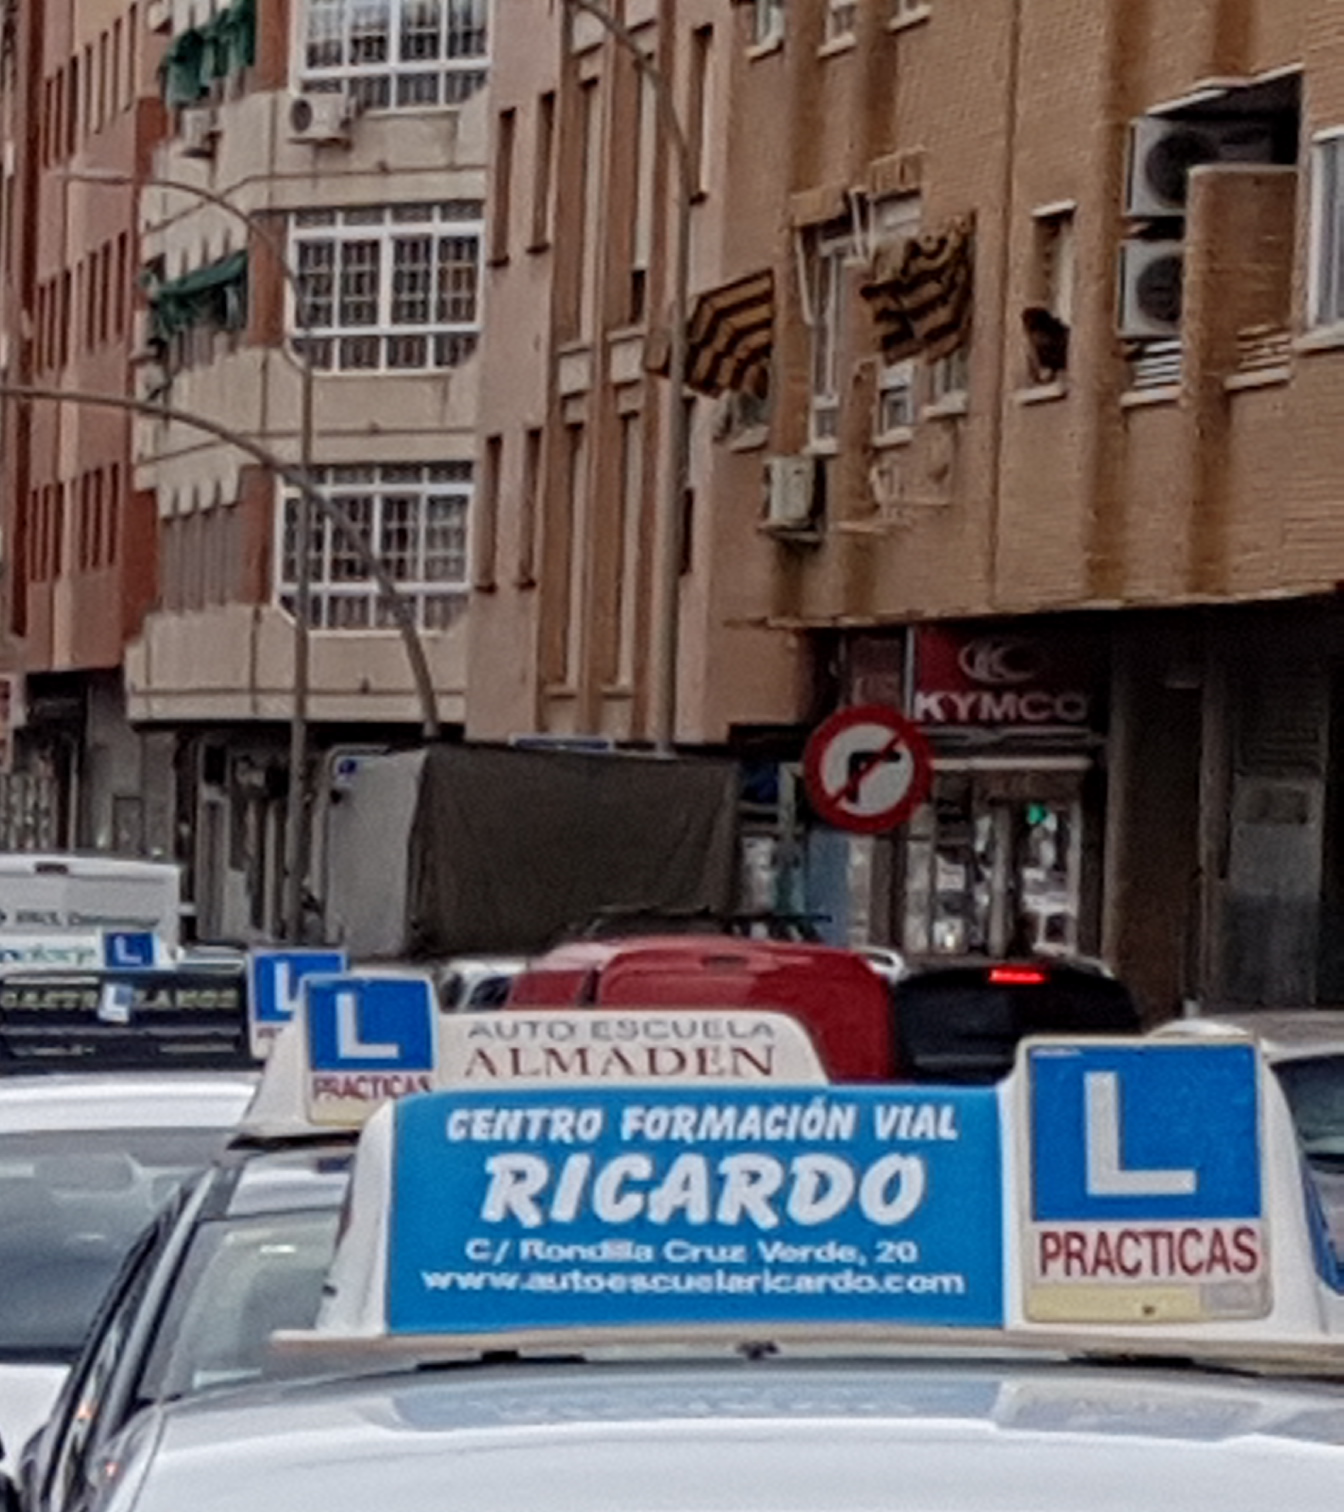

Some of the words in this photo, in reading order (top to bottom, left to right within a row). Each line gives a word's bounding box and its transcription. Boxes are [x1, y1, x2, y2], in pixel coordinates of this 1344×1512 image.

[915, 690, 1088, 721] KYMCO
[113, 935, 142, 963] L
[336, 993, 399, 1059] L
[467, 1019, 577, 1041] AUTO
[590, 1018, 775, 1040] ESCUELA
[464, 1045, 776, 1078] ALMADEN
[446, 1108, 604, 1141] CENTRO
[620, 1096, 857, 1141] FORMACIÓN
[873, 1105, 958, 1140] VIAL
[1084, 1071, 1197, 1195] L
[479, 1152, 927, 1230] RICARDO
[465, 1238, 509, 1264] C/
[520, 1238, 653, 1263] Rondilla
[663, 1240, 747, 1263] Cruz
[758, 1240, 867, 1266] Verde,
[876, 1240, 917, 1264] 20
[1039, 1227, 1259, 1277] PRACTICAS
[420, 1269, 966, 1294] www.autoescuelaricardo.com
